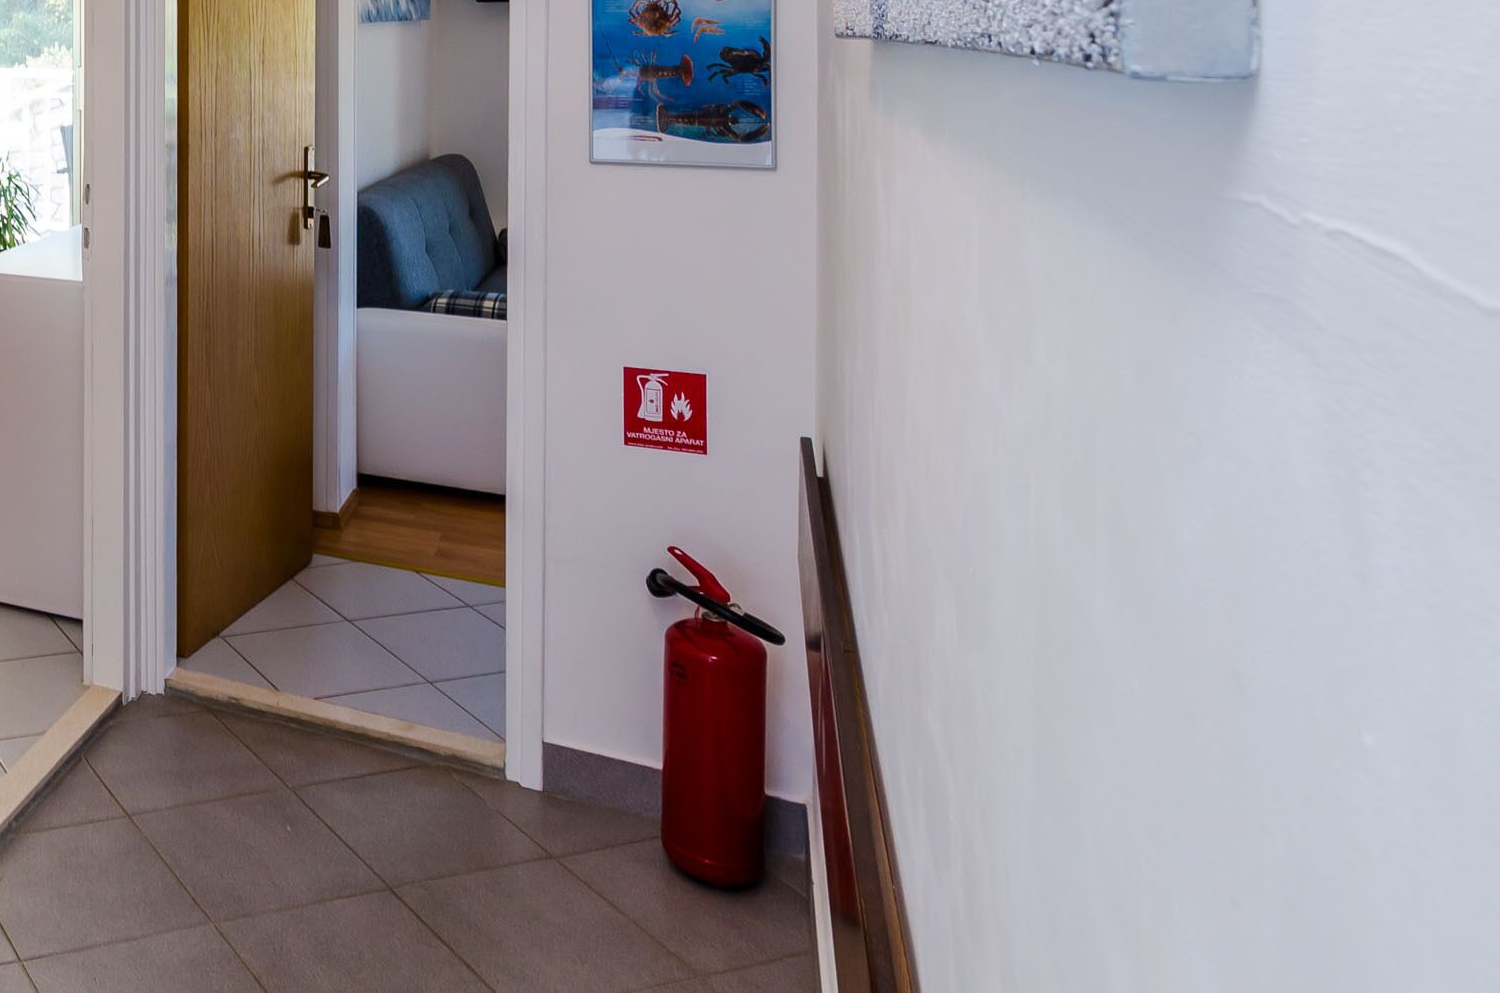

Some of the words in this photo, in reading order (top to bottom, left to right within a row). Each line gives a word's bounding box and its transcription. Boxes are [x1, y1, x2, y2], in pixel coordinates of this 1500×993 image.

[626, 431, 674, 442] VATROGASNI
[675, 438, 704, 446] APARAT
[643, 427, 674, 437] MJESTO
[676, 430, 687, 438] ZA
